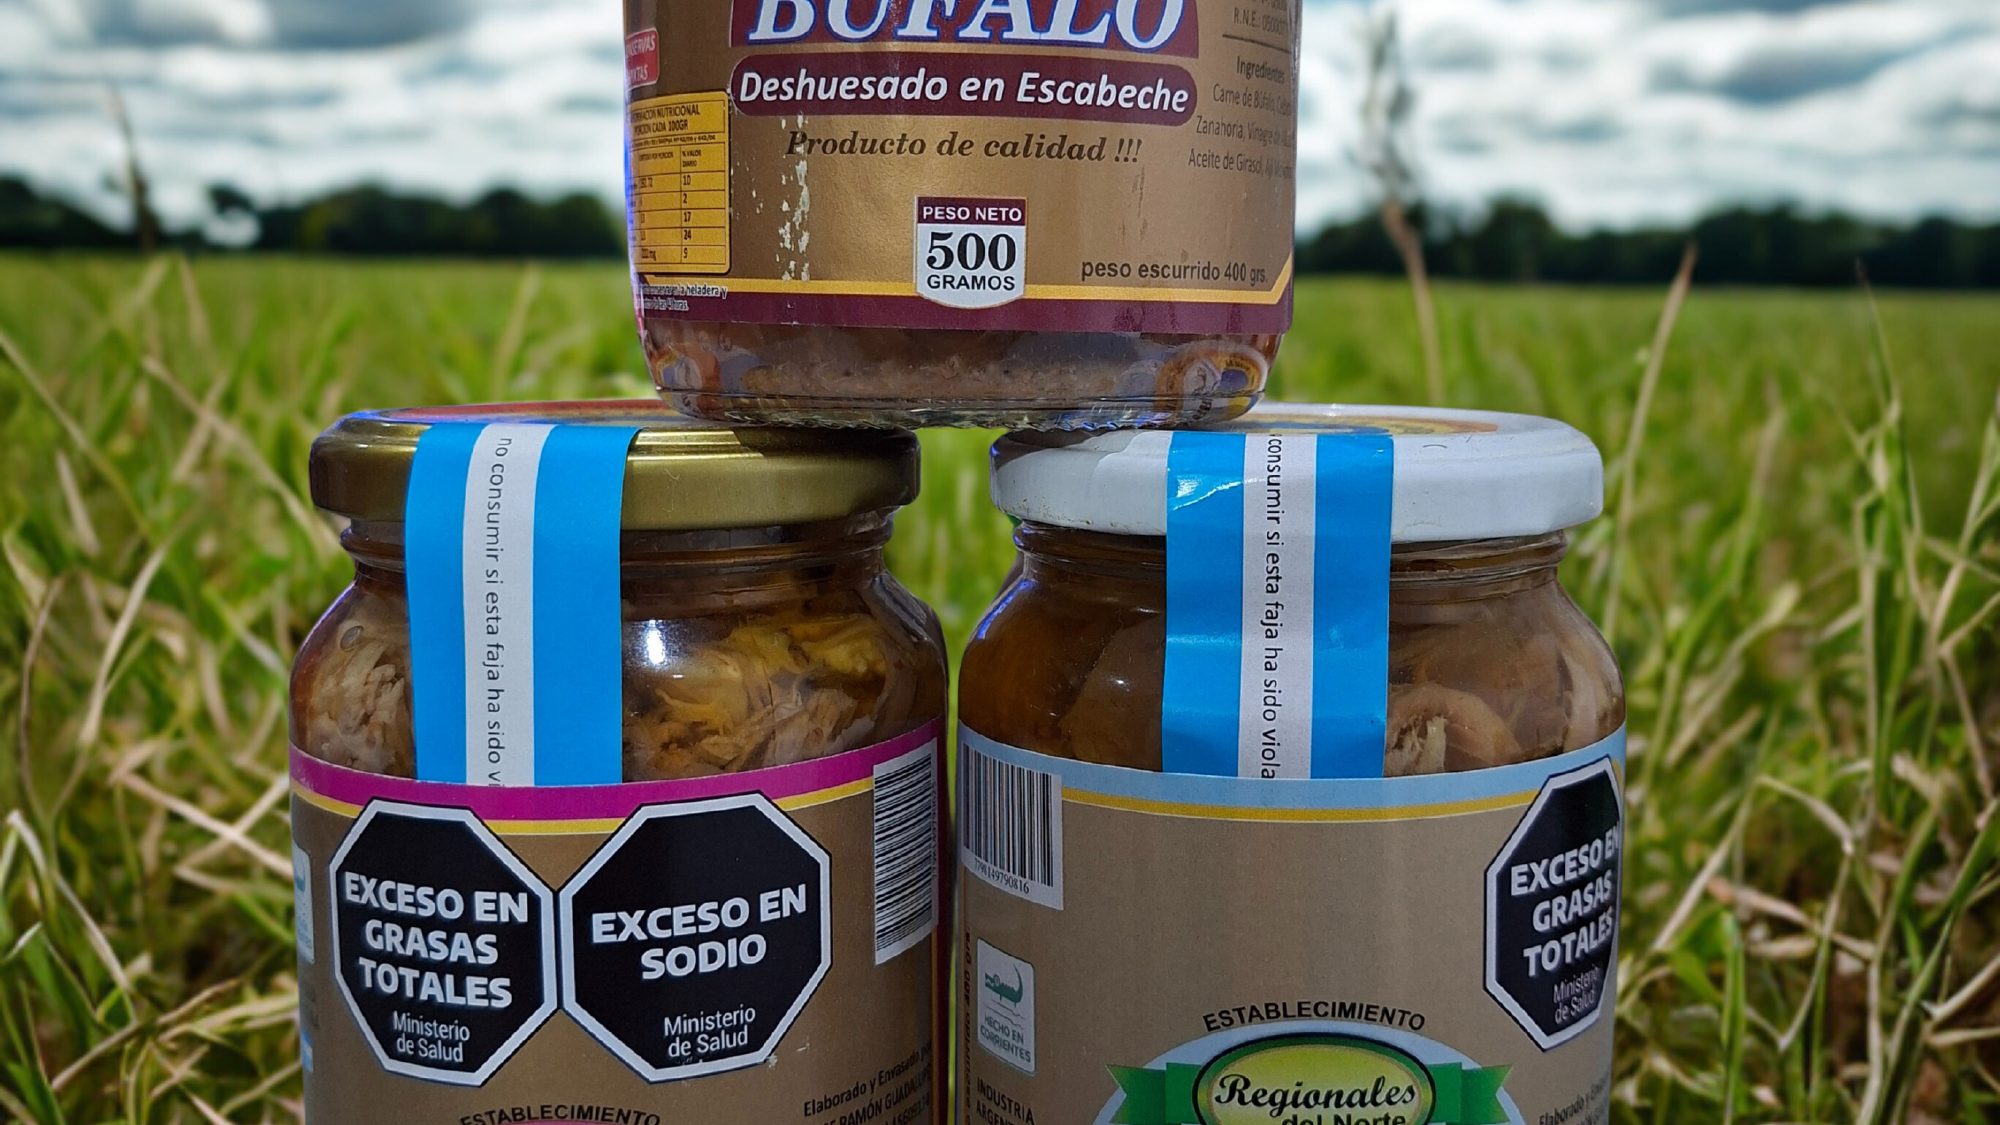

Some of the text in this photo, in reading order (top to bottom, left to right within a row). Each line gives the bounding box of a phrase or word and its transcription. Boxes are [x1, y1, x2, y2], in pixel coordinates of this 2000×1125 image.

[740, 68, 1189, 113] Deshuesado en Escabeche
[1213, 83, 1240, 106] Carne
[1242, 87, 1253, 107] de
[657, 104, 700, 119] NUTRICIONAL
[1196, 115, 1245, 143] Zanahoria,
[787, 130, 1143, 163] Producto de calidad !!!
[1188, 149, 1221, 170] Aceite
[1223, 151, 1234, 171] de
[683, 175, 691, 185] 10
[683, 193, 688, 204] 2
[922, 206, 1022, 222] PESO NETO
[683, 211, 691, 222] 17
[683, 229, 692, 240] 24
[926, 231, 1016, 271] 500
[926, 274, 1016, 291] GRAMOS
[1081, 260, 1131, 280] peso
[1138, 261, 1220, 282] escurrido
[1223, 263, 1247, 282] 400
[687, 283, 720, 297] heladera
[721, 286, 728, 299] y
[495, 437, 512, 457] no
[1266, 438, 1285, 525] consumir
[486, 463, 505, 562] consumir
[1266, 530, 1285, 546] si
[485, 569, 504, 584] si
[1265, 552, 1283, 594] esta
[485, 591, 502, 635] esta
[1260, 601, 1284, 639] faja
[482, 642, 505, 681] faja
[1264, 648, 1284, 672] ha
[487, 689, 505, 713] ha
[1262, 678, 1282, 722] sido
[487, 720, 506, 764] sido
[1261, 729, 1281, 780] viola
[1510, 821, 1619, 897] EXCESO EN
[345, 870, 528, 923] EXCESO EN
[591, 883, 807, 944] EXCESO EN
[1532, 868, 1612, 933] GRASAS
[365, 919, 498, 965] GRASAS
[640, 933, 767, 980] SODIO
[1523, 905, 1612, 978] TOTALES
[358, 956, 512, 1009] TOTALES
[1553, 963, 1600, 1004] Ministerio
[663, 1003, 756, 1037] Ministerio
[1202, 1001, 1425, 1033] ESTABLECIMIENTO
[1555, 983, 1595, 1025] de Salud
[393, 1010, 470, 1043] Ministerio
[668, 1025, 748, 1058] de Salud
[985, 1013, 1024, 1045] HECHO EN
[396, 1034, 463, 1063] de Salud
[980, 1025, 1031, 1063] CORRIENTES
[803, 1081, 867, 1117] Elaborado
[870, 1077, 876, 1095] y
[878, 1049, 921, 1087] Envasado
[1214, 1073, 1417, 1118] Regionales
[460, 1104, 661, 1125] ESTABLECIMIENTO
[839, 1097, 883, 1125] RAMÓN
[977, 1076, 1035, 1125] INDUSTRIA
